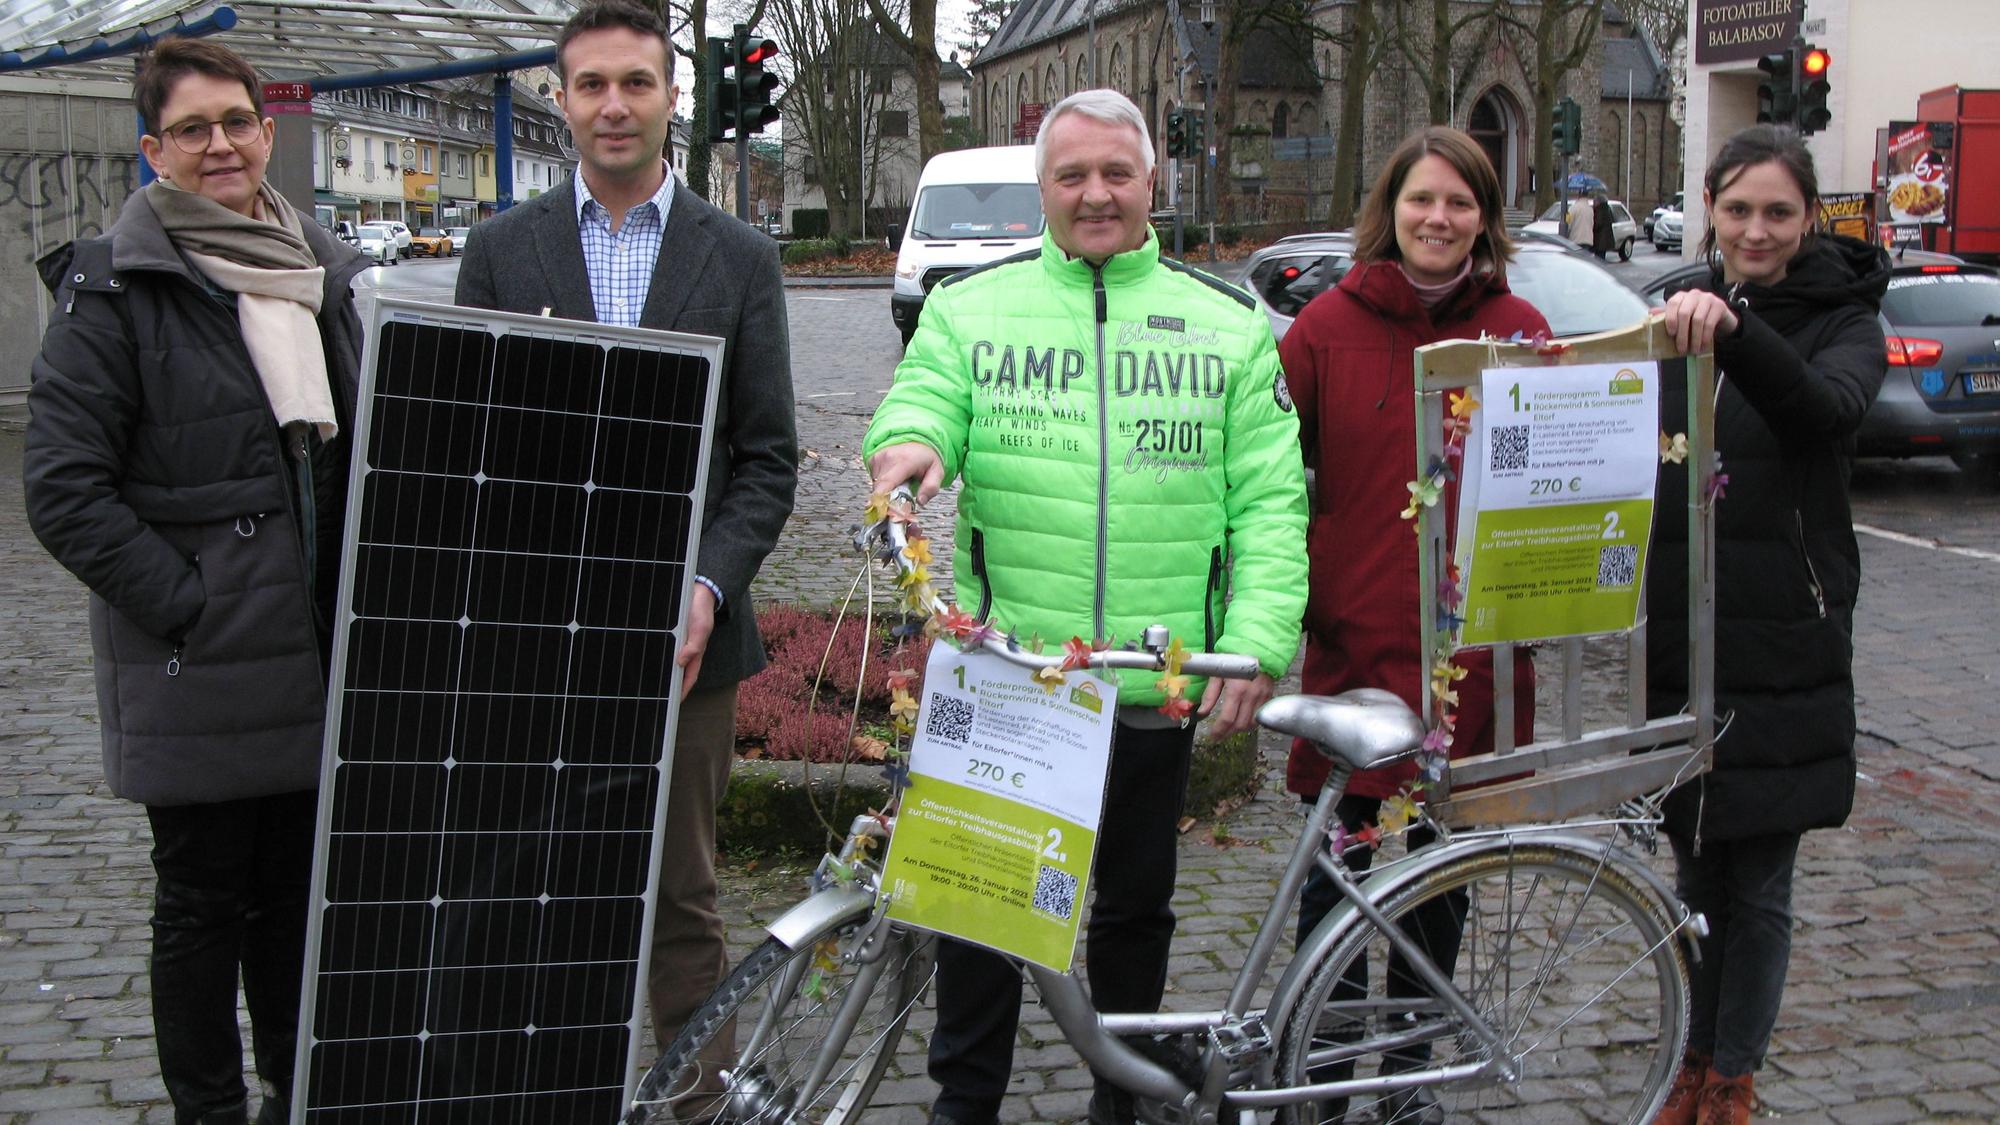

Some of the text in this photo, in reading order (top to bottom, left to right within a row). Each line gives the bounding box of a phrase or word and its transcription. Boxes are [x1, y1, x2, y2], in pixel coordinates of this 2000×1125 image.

[1703, 1, 1792, 25] FOTOATELIER
[1708, 22, 1786, 47] BALABASOV
[1806, 23, 1820, 33] Markt
[1117, 321, 1166, 346] Blue
[1169, 322, 1220, 348] Label
[971, 340, 1085, 394] CAMP
[1115, 350, 1226, 399] DAVID
[1030, 390, 1057, 401] SEAS
[1508, 382, 1600, 412] 1. Förderprogramm
[1534, 401, 1582, 411] Rückenwind
[1591, 397, 1643, 408] Sonnenschein
[991, 403, 1086, 423] BREAKING WAVES
[1533, 413, 1555, 421] Eitorf
[1011, 419, 1047, 432] WINDS
[1533, 423, 1565, 431] Förderung
[1577, 419, 1616, 429] Anschaffung
[1000, 434, 1079, 452] REEFS OF ICE
[1135, 418, 1203, 454] 25/01
[1124, 446, 1208, 484] Original
[1531, 461, 1540, 469] für
[1586, 458, 1598, 466] mit
[1530, 476, 1582, 496] 270 €
[1601, 511, 1626, 540] 2.
[1481, 533, 1600, 550] zur Eitorfer Treibhausgasbilanz
[1481, 585, 1494, 593] Am
[1551, 577, 1574, 587] Januar
[1550, 588, 1562, 596] Uhr
[1568, 585, 1591, 595] Online
[953, 664, 976, 693] 1.
[978, 706, 1015, 722] Förderung
[1017, 714, 1030, 722] der
[979, 698, 1005, 710] Eitorf
[980, 688, 1038, 705] Rückenwind
[1048, 700, 1101, 727] Sonnenschein
[976, 721, 991, 729] und
[992, 725, 1006, 733] von
[1047, 732, 1060, 741] und
[972, 740, 983, 749] für
[1034, 758, 1047, 770] mit
[966, 758, 1027, 789] 270 €
[907, 807, 1041, 854] zur Eitorfer Treibhausgasbilanz
[920, 798, 1044, 843] Öffentlichkeitsveranstaltung
[1042, 827, 1068, 864] 2.
[903, 856, 1029, 899] Am Donnerstag, 26. Januar 2023
[930, 873, 951, 885] 19:00
[956, 879, 980, 894] 20:00
[980, 888, 996, 899] Uhr
[1000, 894, 1027, 909] Online
